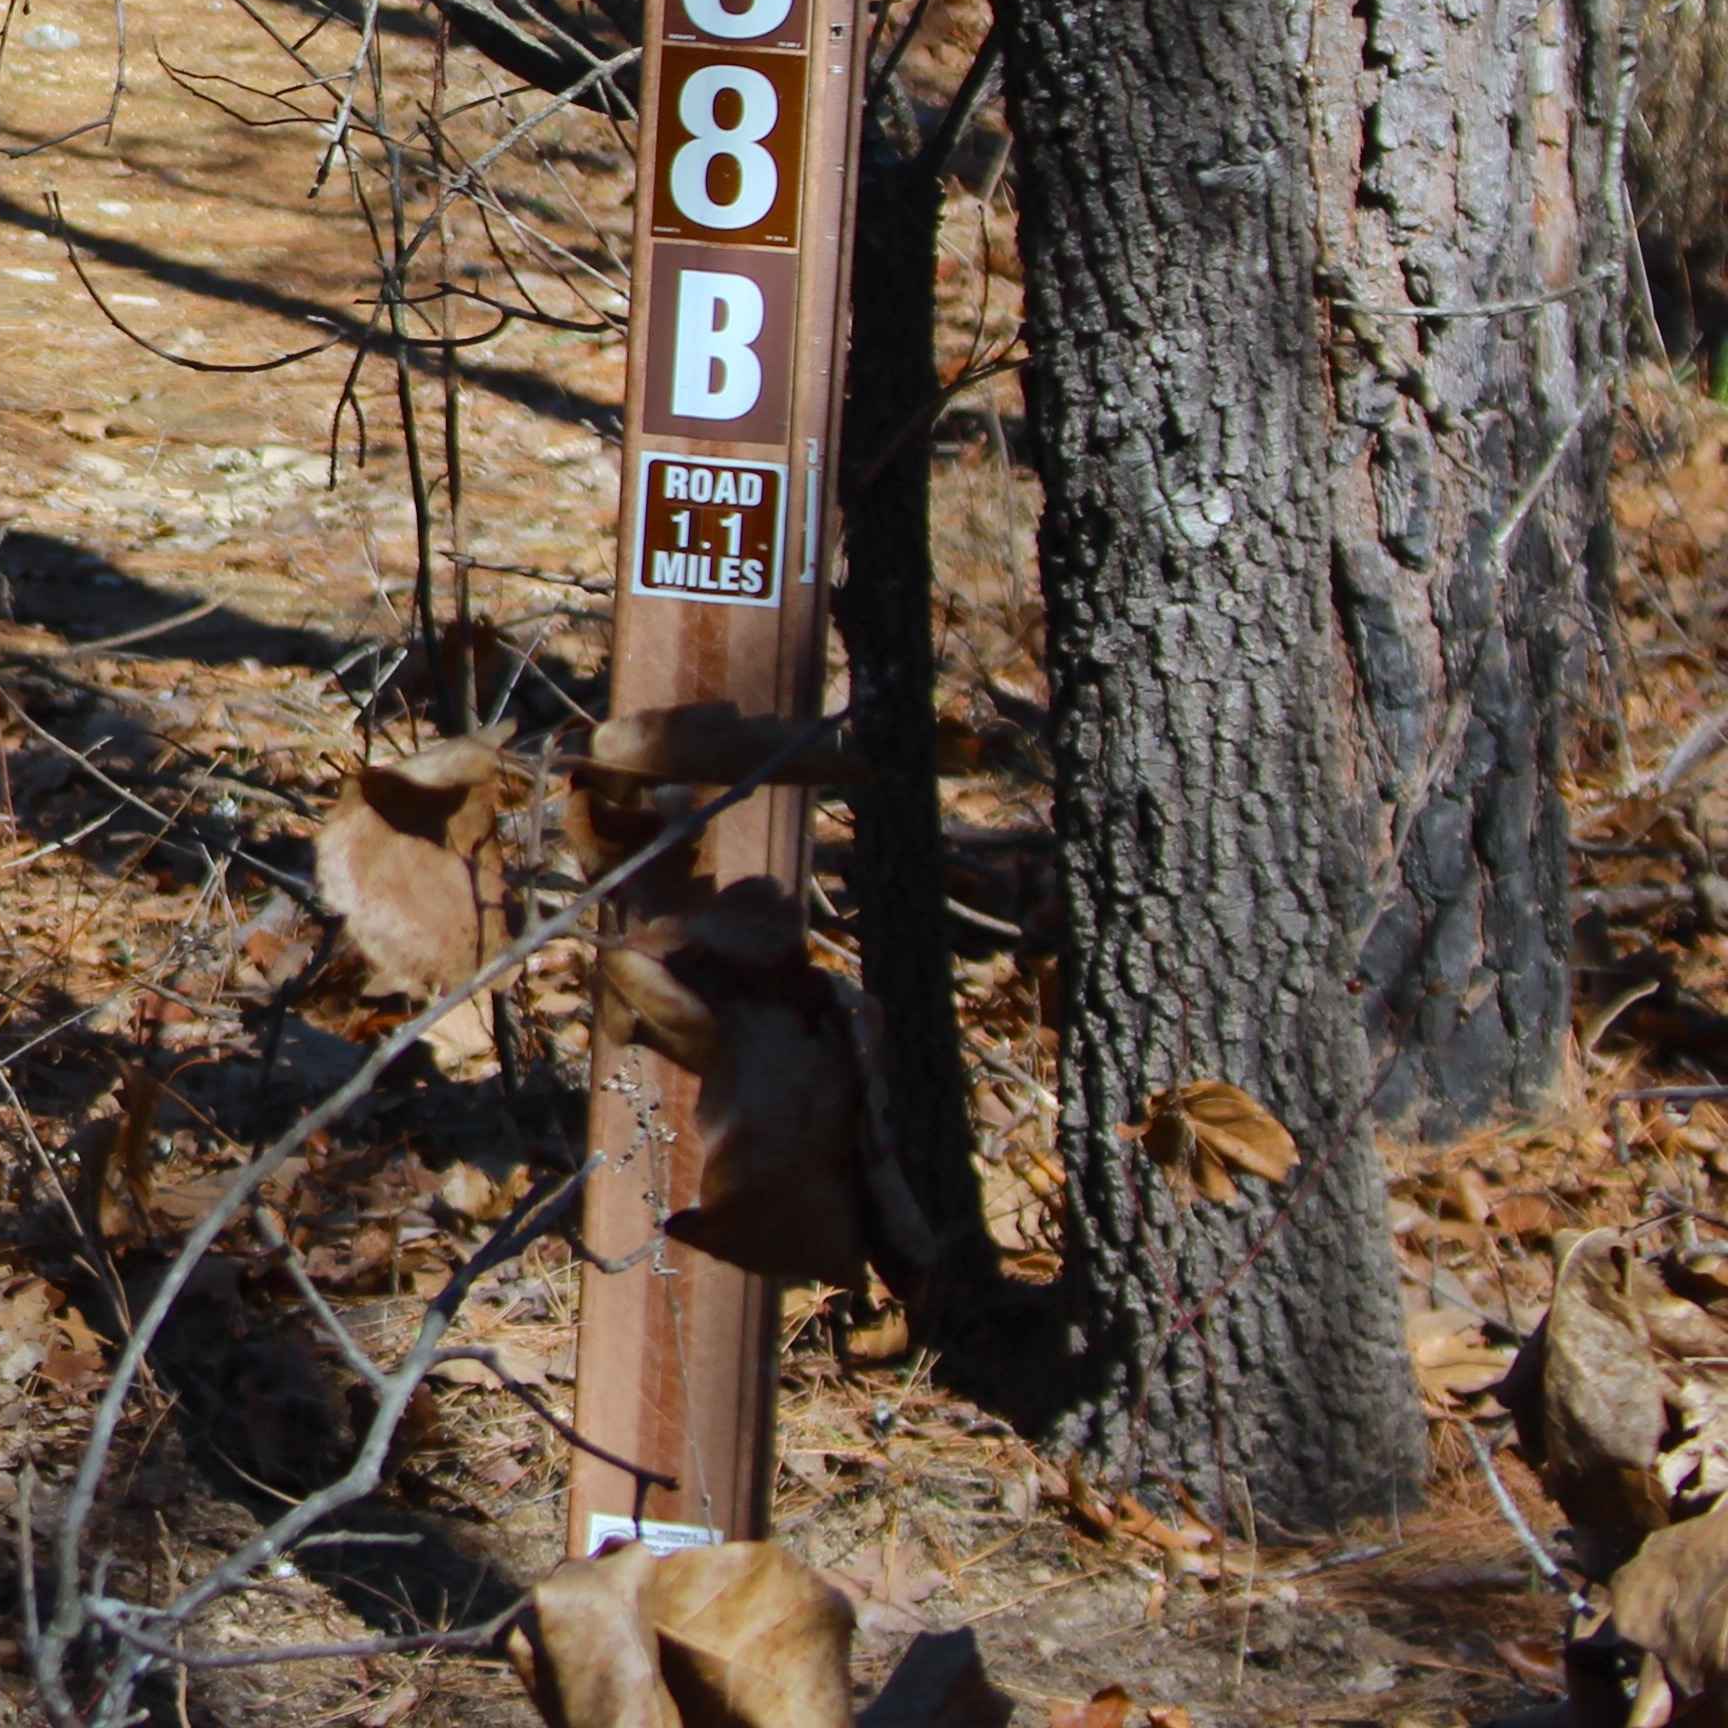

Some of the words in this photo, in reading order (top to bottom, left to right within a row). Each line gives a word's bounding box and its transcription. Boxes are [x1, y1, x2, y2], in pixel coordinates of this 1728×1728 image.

[663, 465, 764, 507] ROAD
[670, 510, 743, 556] 1.1
[652, 550, 765, 594] MILES
